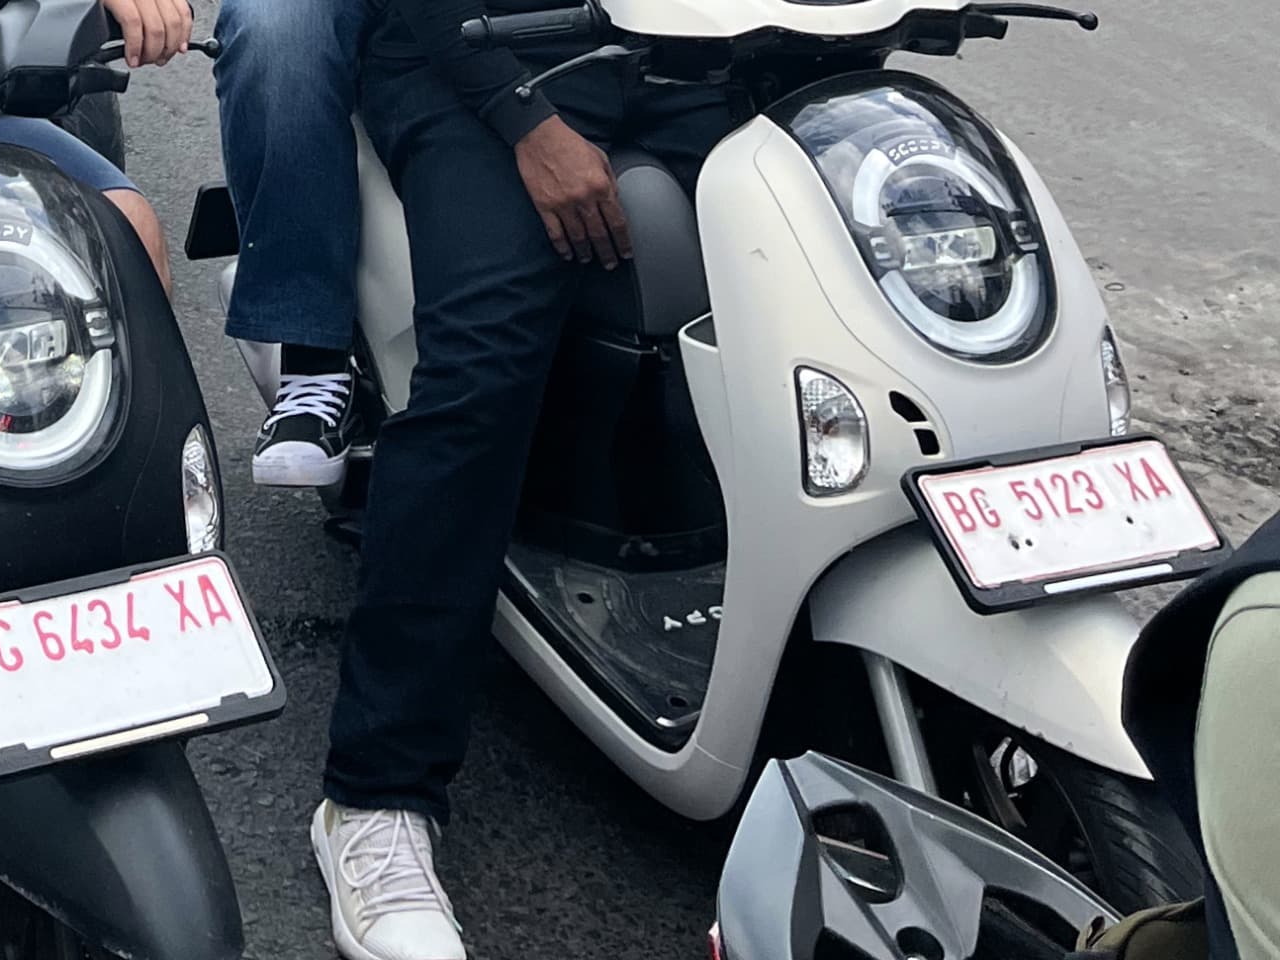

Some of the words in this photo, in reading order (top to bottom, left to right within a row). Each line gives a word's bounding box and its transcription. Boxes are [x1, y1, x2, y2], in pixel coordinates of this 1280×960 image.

[888, 139, 951, 161] SCOOPY
[942, 487, 1002, 534] BG
[1008, 469, 1105, 522] 5123
[1113, 457, 1172, 502] XA
[32, 591, 151, 661] 6434
[163, 573, 232, 633] XA
